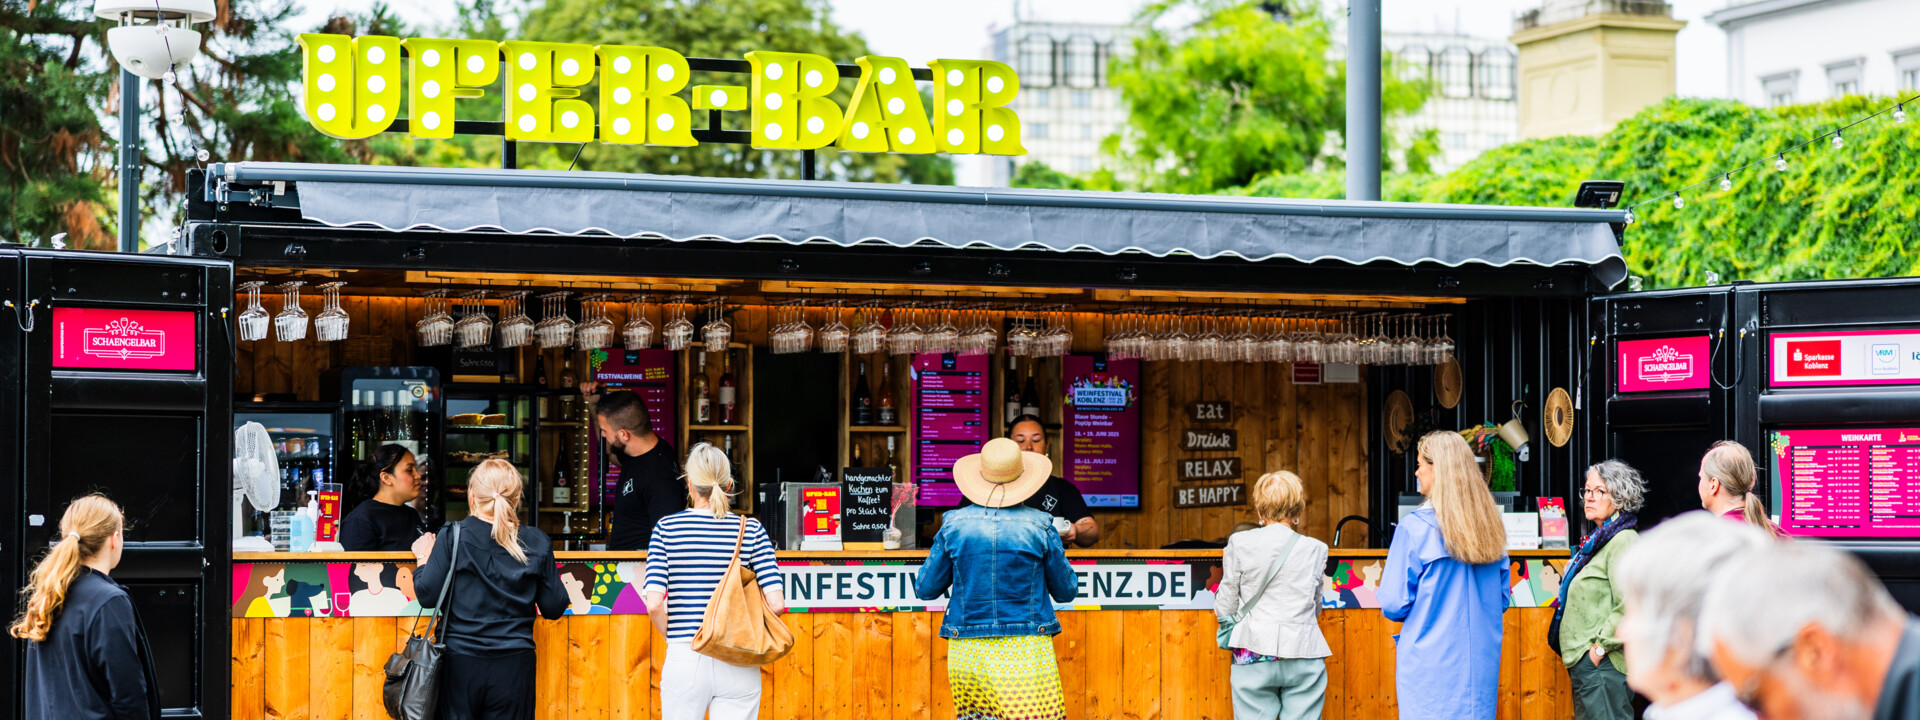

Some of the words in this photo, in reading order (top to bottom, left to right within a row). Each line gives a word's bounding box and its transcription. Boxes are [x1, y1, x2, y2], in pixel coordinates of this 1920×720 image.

[297, 32, 1028, 156] UFER-BAR
[92, 337, 156, 347] SCHAENGELBAR
[1644, 362, 1687, 372] SCHAENGELBAR
[1196, 404, 1224, 419] Eat
[1187, 432, 1230, 448] Drink
[1185, 460, 1233, 477] RELAX
[845, 474, 892, 484] handgemachter
[848, 483, 873, 494] Kuchen
[1179, 489, 1195, 504] BE
[1199, 486, 1240, 503] HAPPY
[846, 508, 857, 516] pro
[852, 522, 870, 530] Sahne
